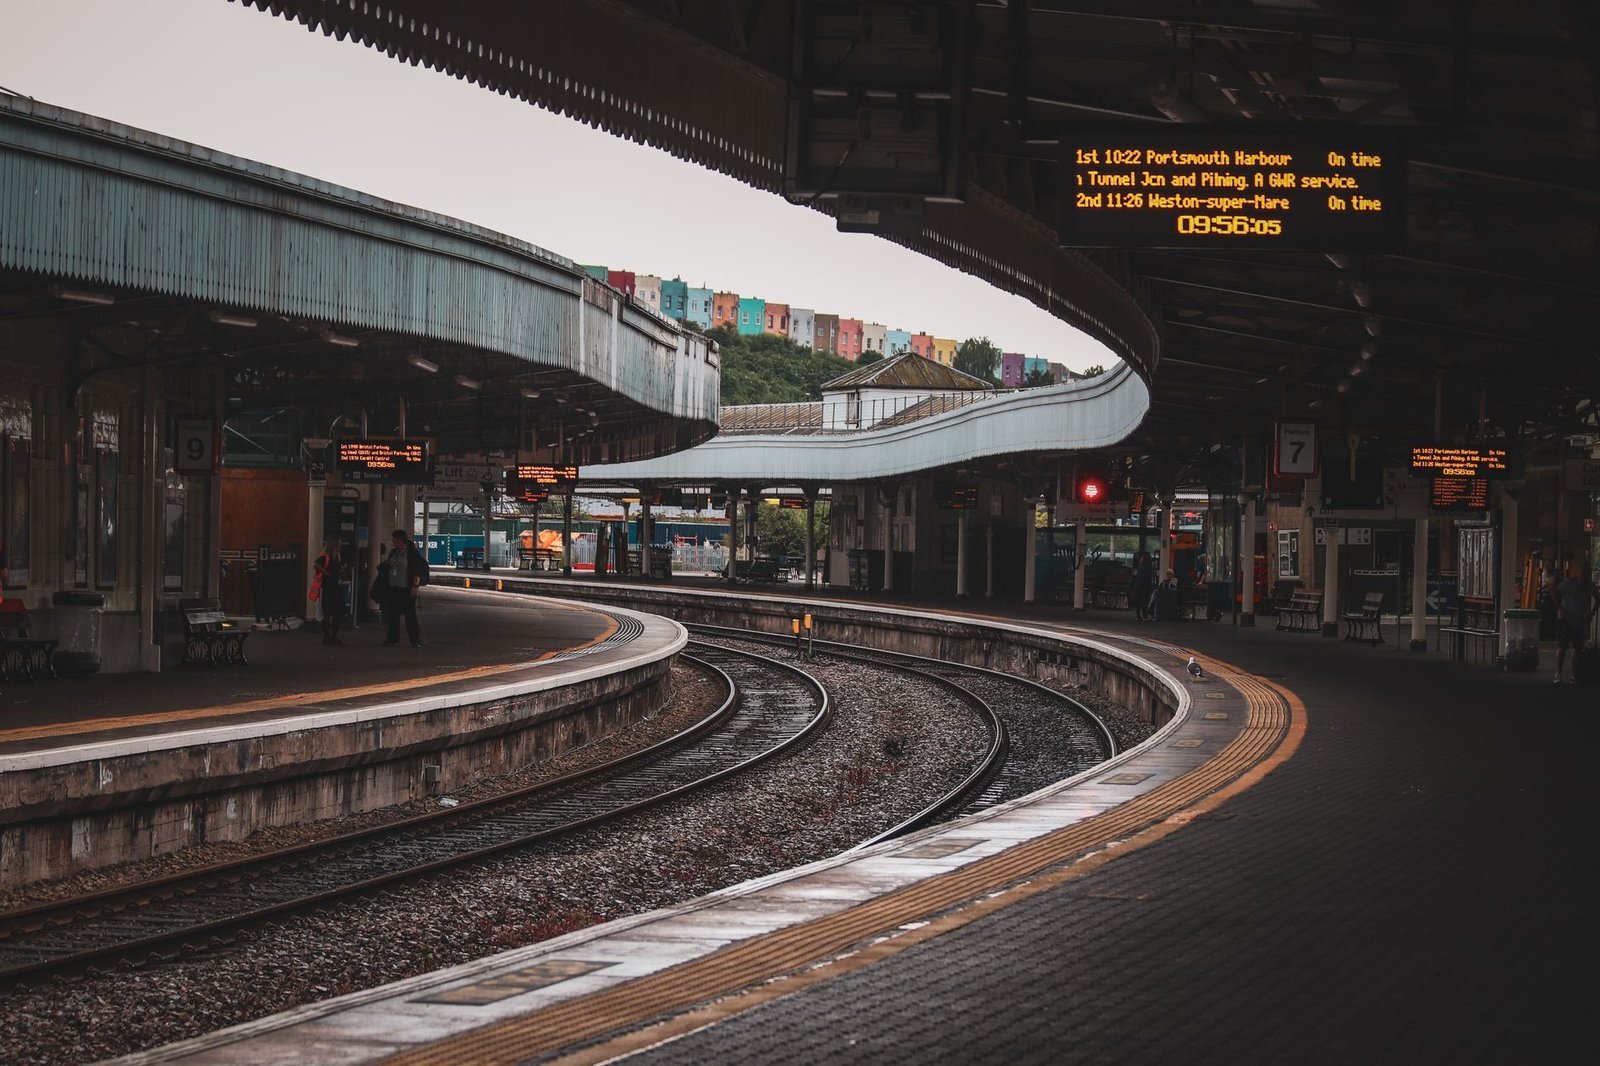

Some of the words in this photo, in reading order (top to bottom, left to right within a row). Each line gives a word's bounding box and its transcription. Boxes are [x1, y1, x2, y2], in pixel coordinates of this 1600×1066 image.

[1076, 149, 1100, 165] 1st
[1104, 149, 1142, 165] 10:22
[1145, 150, 1230, 166] Portsmouth
[1235, 150, 1293, 166] Harbour
[1327, 152, 1346, 167] On
[1350, 151, 1382, 167] time
[1087, 171, 1136, 186] Tunnel
[1140, 171, 1166, 187] Jcn
[1170, 171, 1197, 187] and
[1200, 172, 1250, 190] Pilning.
[1254, 173, 1264, 187] A
[1268, 173, 1296, 188] GWR
[1300, 174, 1359, 188] service.
[1076, 192, 1103, 208] 2nd
[1106, 193, 1144, 208] 11:26
[1148, 193, 1290, 212] Weston-super-Mare
[1327, 195, 1346, 210] On
[1350, 195, 1382, 211] time
[1177, 214, 1282, 235] 09:56:05
[187, 437, 204, 461] 9
[1289, 440, 1306, 464] 7
[445, 467, 463, 478] Lift
